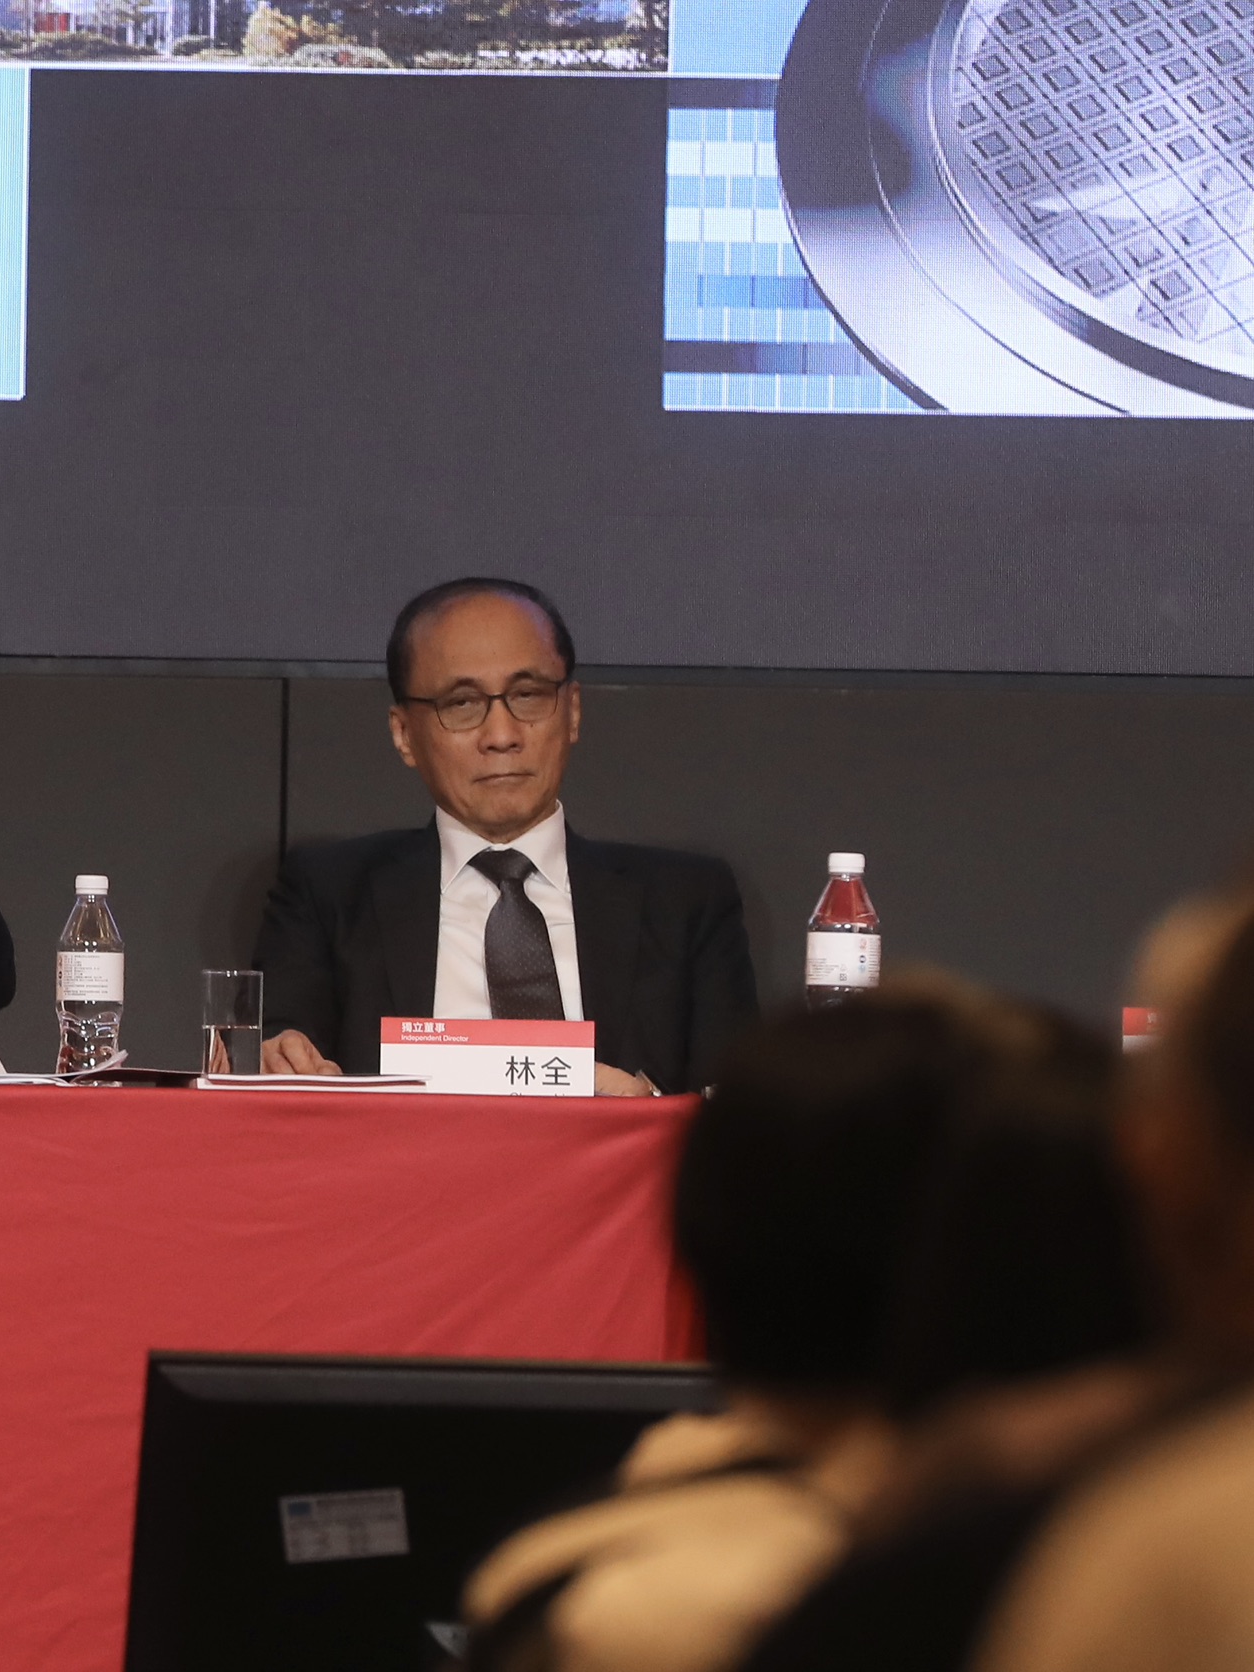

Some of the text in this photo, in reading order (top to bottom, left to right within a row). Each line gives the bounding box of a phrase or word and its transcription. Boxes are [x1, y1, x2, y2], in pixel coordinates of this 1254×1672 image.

[401, 1022, 446, 1033] 獨立董事
[401, 1034, 442, 1042] Independent
[505, 1056, 572, 1086] 林全
